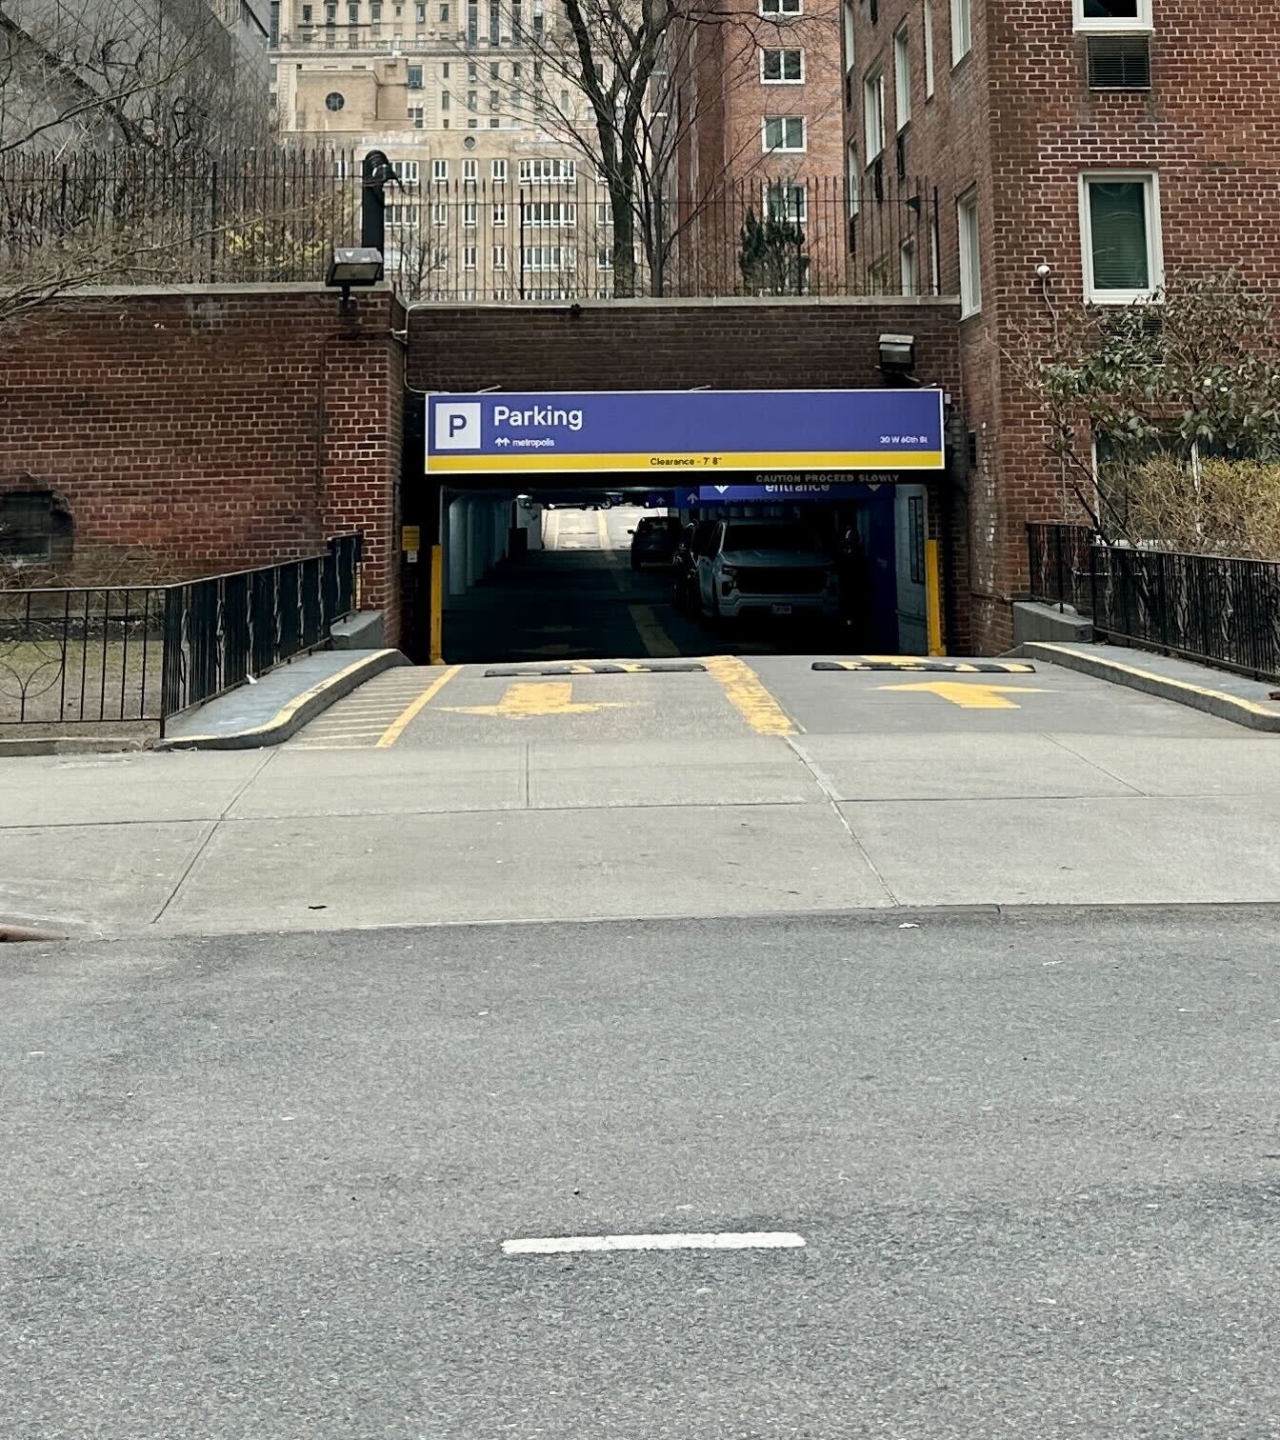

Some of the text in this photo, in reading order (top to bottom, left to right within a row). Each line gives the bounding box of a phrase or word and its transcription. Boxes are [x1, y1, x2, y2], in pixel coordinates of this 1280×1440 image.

[494, 405, 583, 431] Parking
[449, 414, 467, 438] P
[512, 438, 555, 448] metropolis
[891, 435, 900, 444] W
[650, 457, 695, 466] Clearance
[805, 474, 854, 482] PROCEED
[858, 474, 900, 482] SLOWLY
